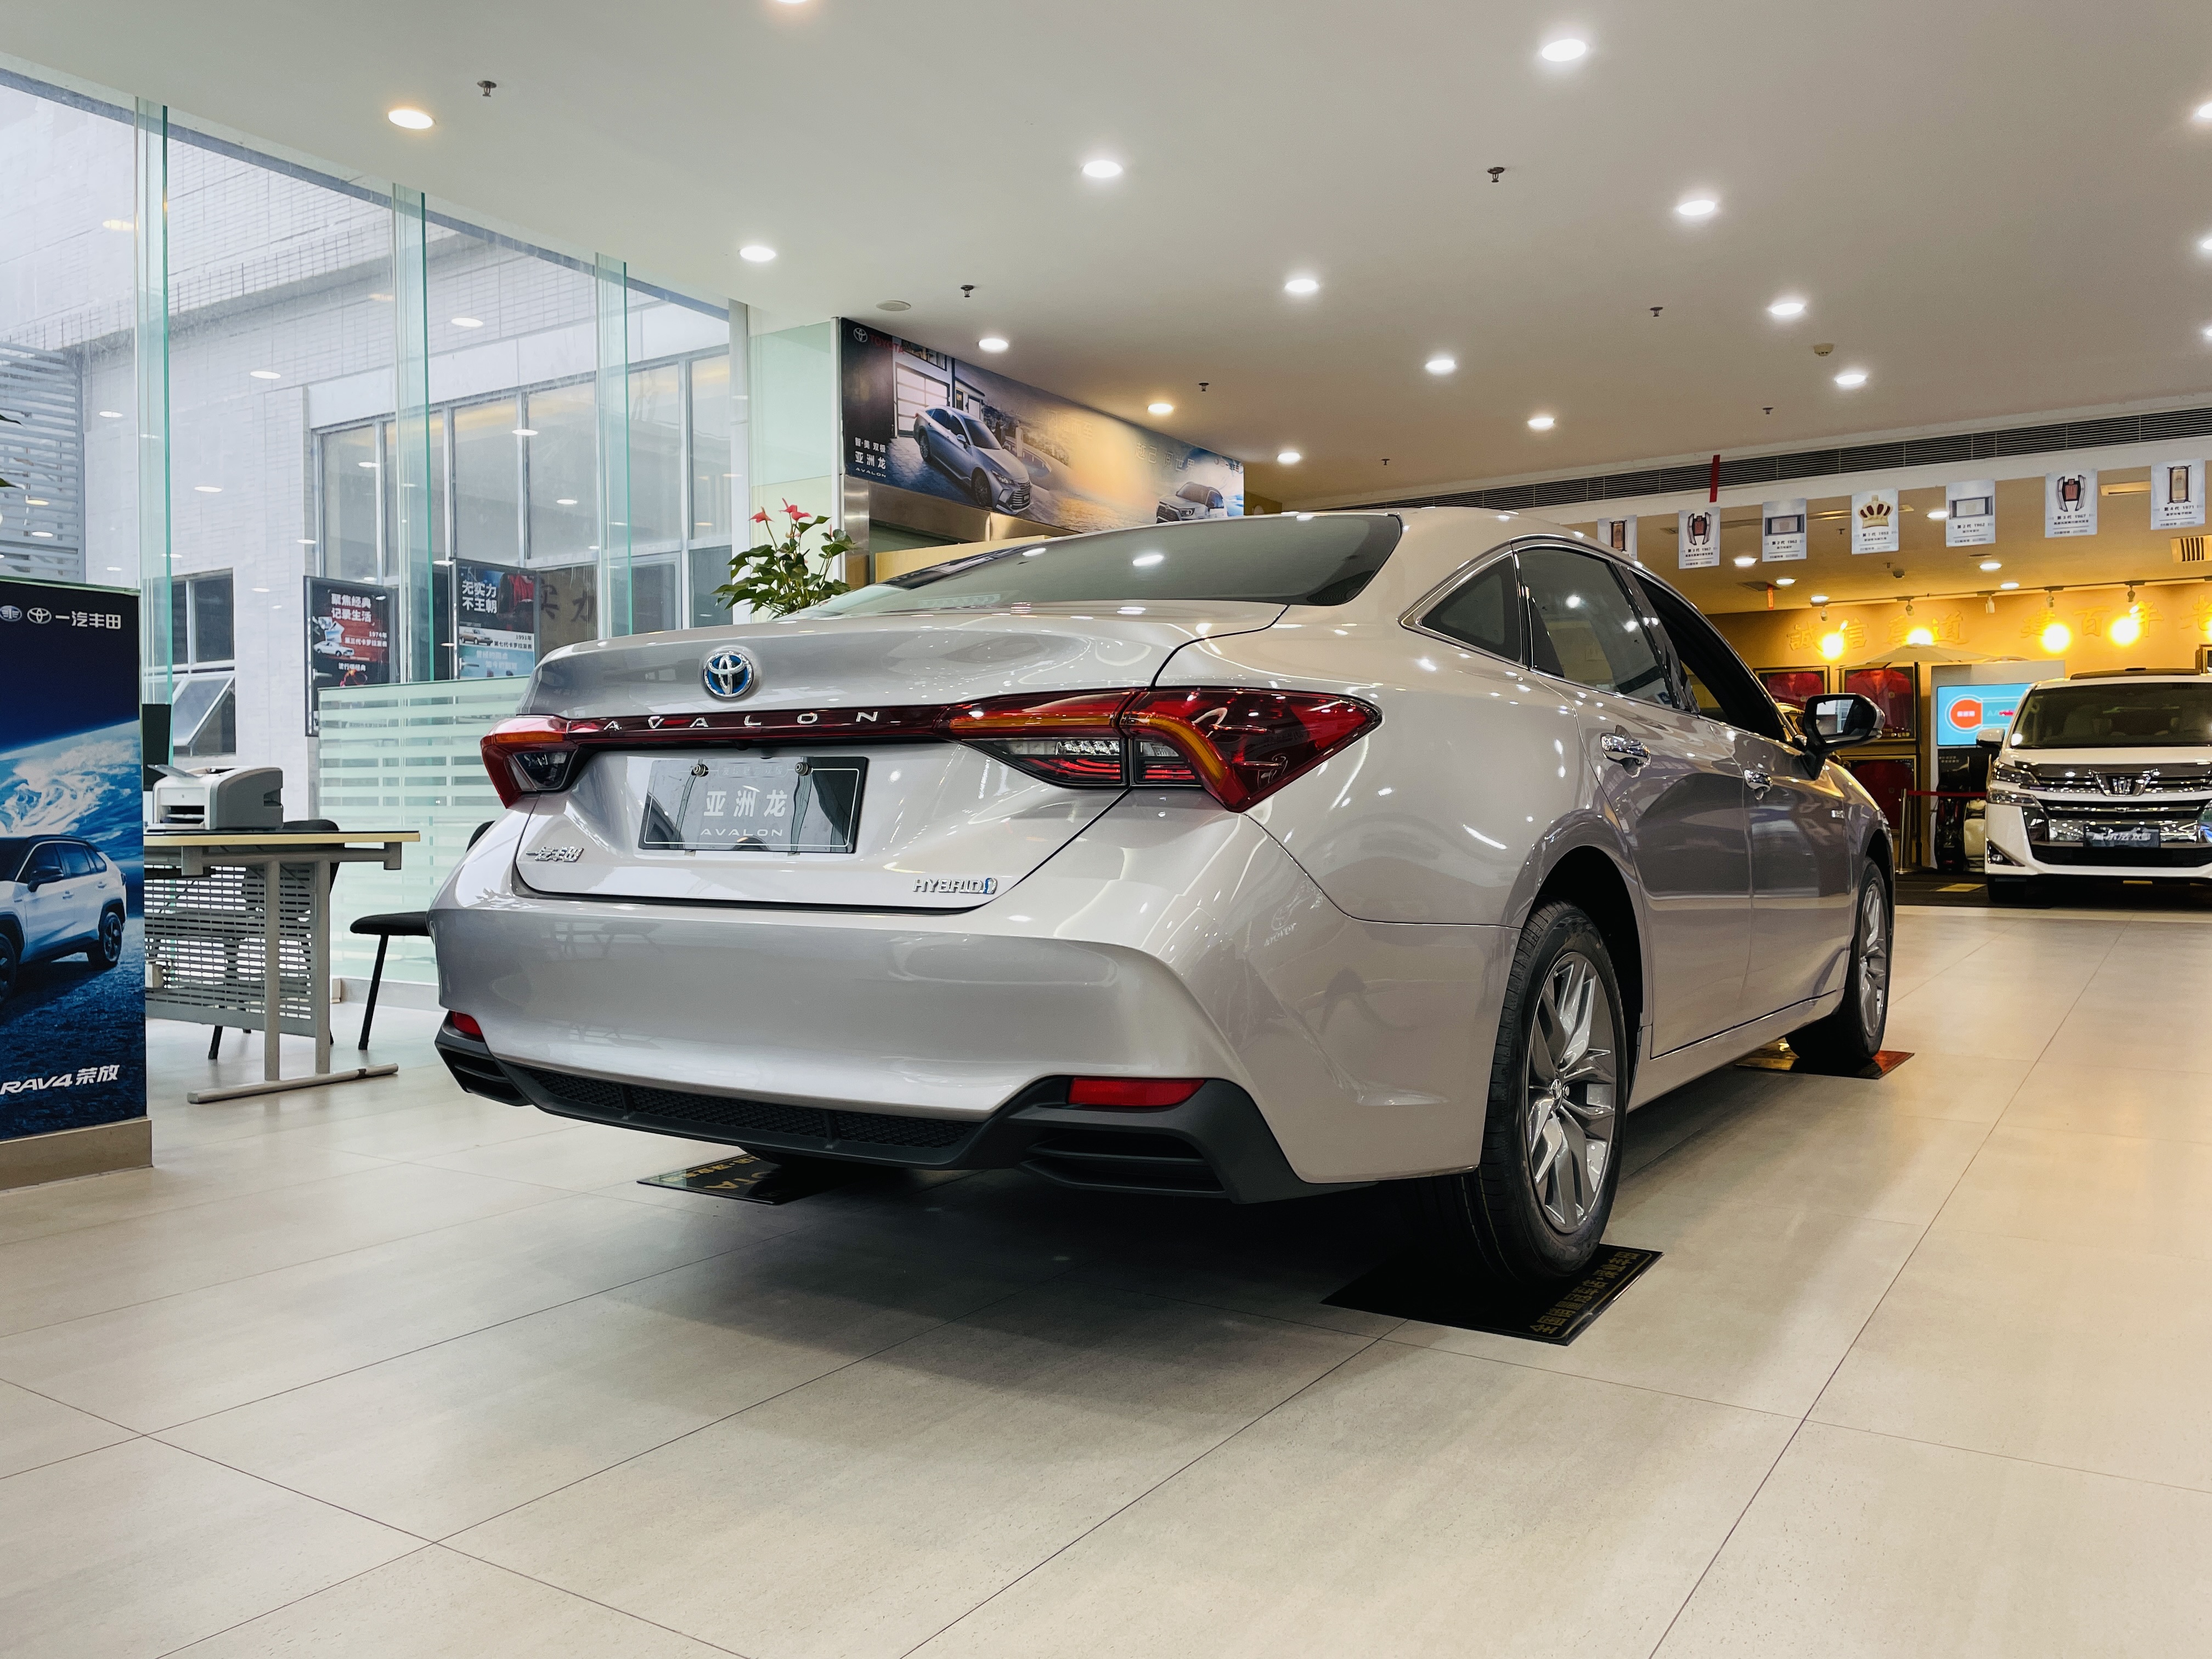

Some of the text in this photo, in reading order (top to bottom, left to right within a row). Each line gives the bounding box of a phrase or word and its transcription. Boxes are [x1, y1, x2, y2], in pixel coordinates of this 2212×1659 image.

[855, 450, 886, 470] 亚洲龙
[856, 467, 887, 478] AVALON
[331, 593, 371, 609] 聚焦经典
[462, 596, 497, 614] 不王朝
[55, 611, 121, 629] 一汽丰田
[331, 607, 371, 623] 记录生活
[603, 711, 878, 731] AVALON
[703, 789, 788, 817] 亚洲龙
[700, 828, 783, 837] AVALON
[912, 878, 984, 894] HYBRID
[0, 1065, 120, 1095] RAV4 荣放
